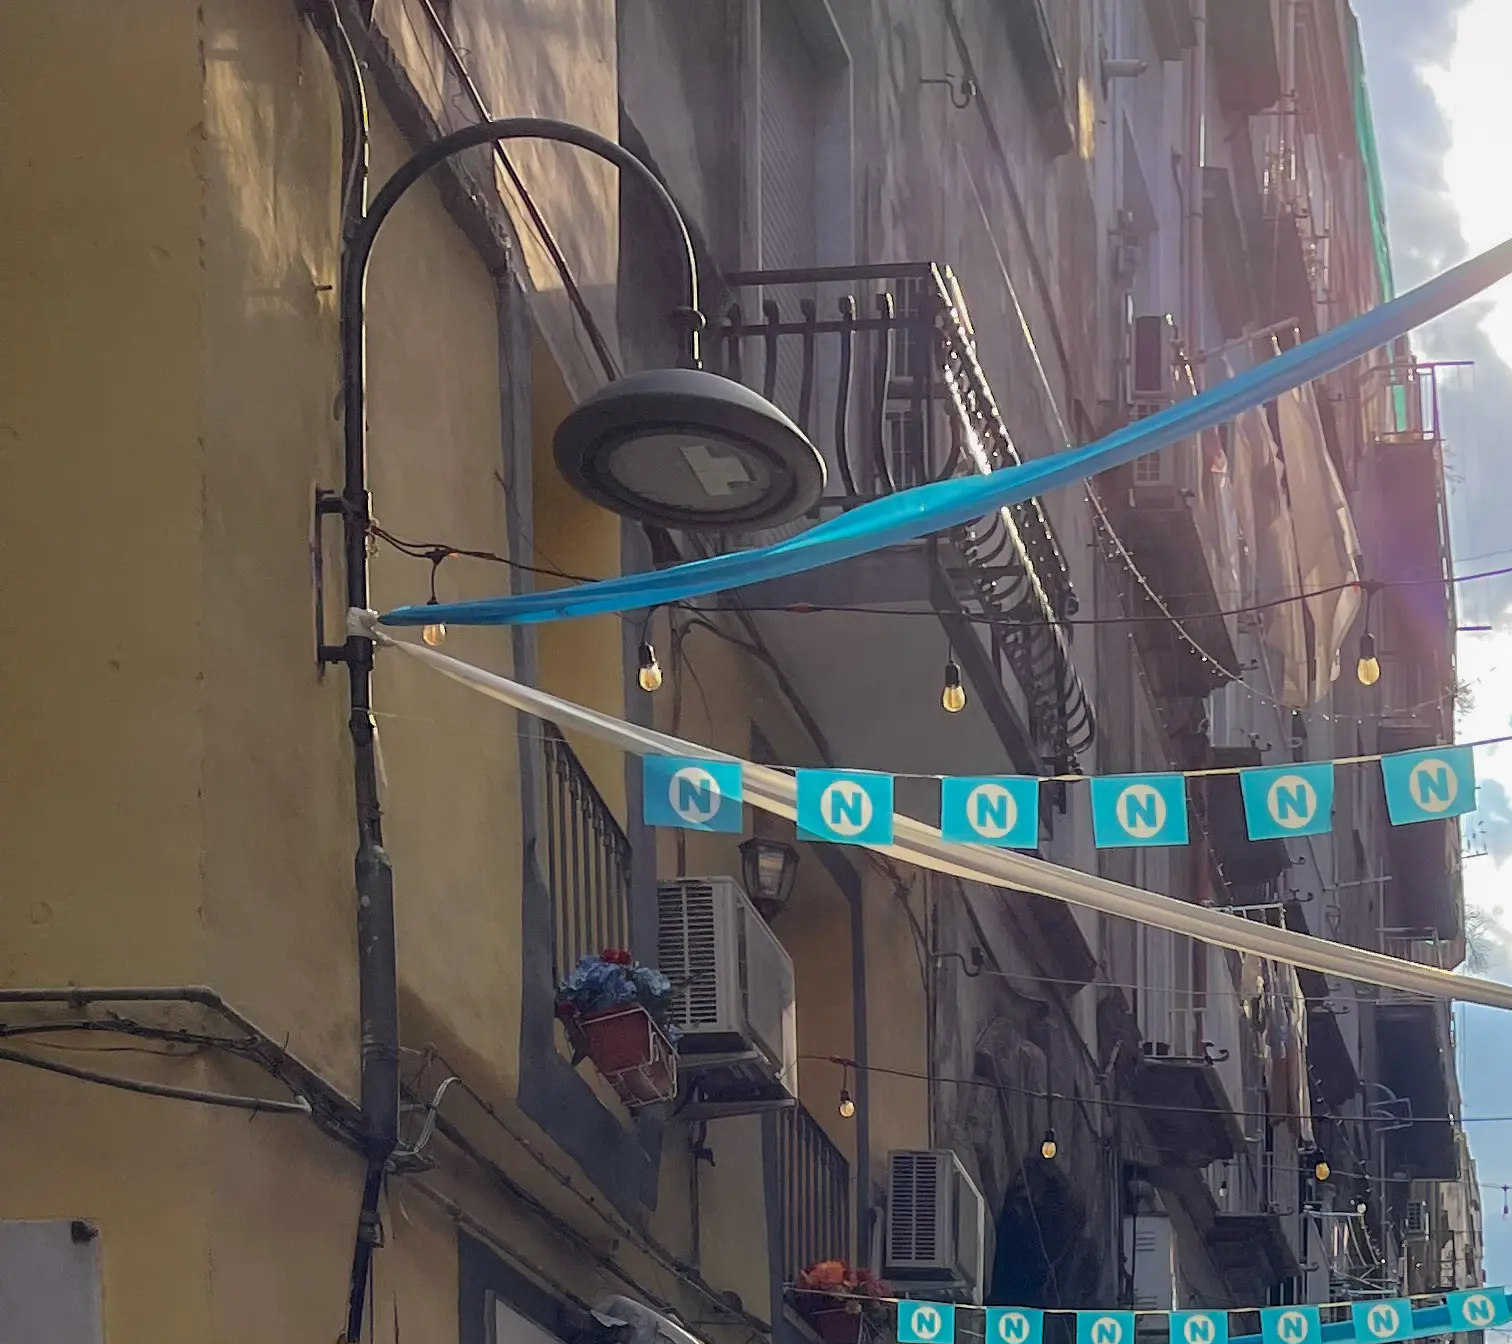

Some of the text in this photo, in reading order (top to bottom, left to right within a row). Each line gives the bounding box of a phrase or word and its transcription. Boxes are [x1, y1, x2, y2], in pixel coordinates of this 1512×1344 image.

[679, 777, 710, 813] N
[1417, 767, 1448, 803] N
[831, 790, 862, 825] N
[977, 793, 1007, 828] N
[1126, 793, 1156, 828] N
[1276, 784, 1308, 820] N
[1373, 1310, 1393, 1332] N
[1468, 1300, 1489, 1321] N
[917, 1312, 935, 1333] N
[1005, 1318, 1023, 1338] N
[1190, 1320, 1208, 1341] N
[1283, 1317, 1302, 1338] N
[1097, 1324, 1115, 1344] N
